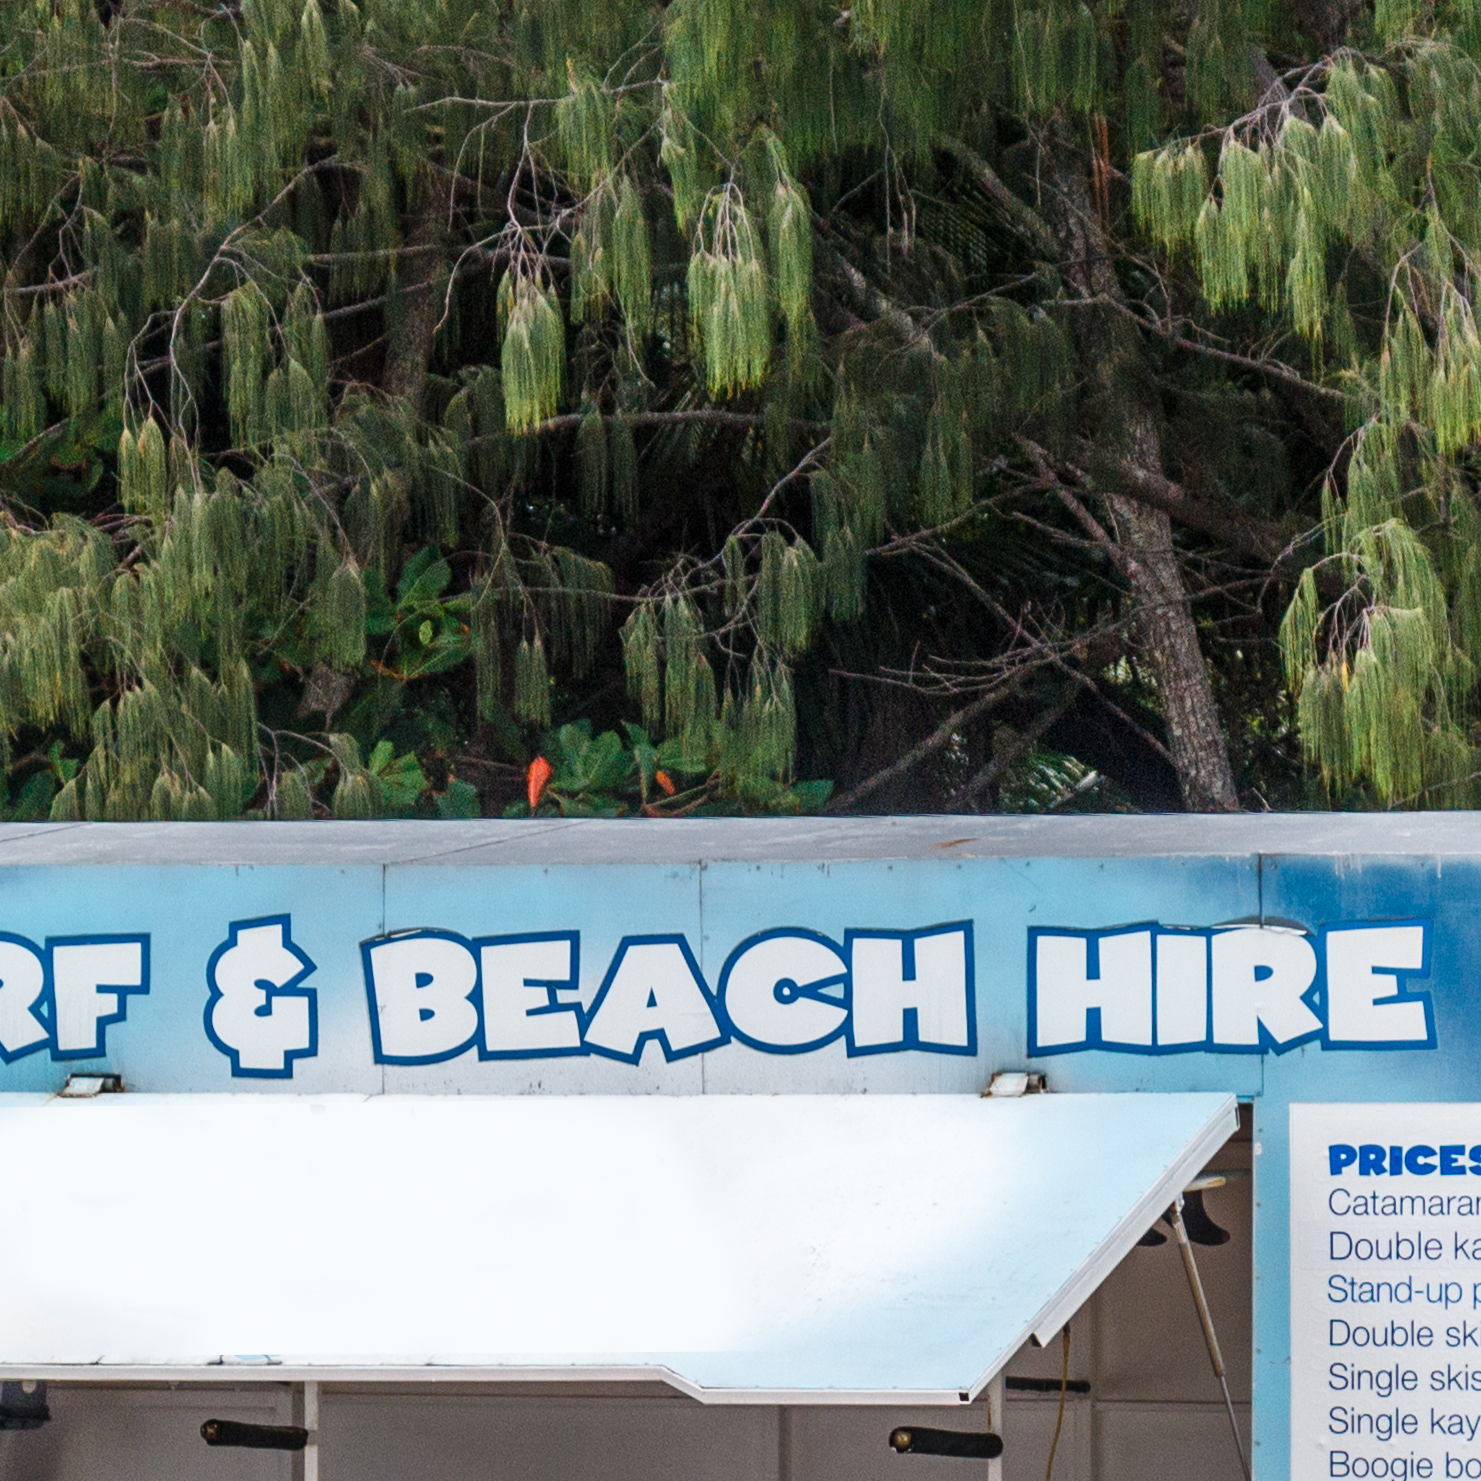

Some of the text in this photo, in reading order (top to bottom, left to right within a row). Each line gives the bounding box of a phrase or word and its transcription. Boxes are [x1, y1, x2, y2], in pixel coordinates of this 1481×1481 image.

[204, 913, 318, 1079] &
[359, 920, 978, 1066] BEACH
[1027, 917, 1438, 1057] HIRE
[1329, 1230, 1443, 1261] Double
[1327, 1273, 1463, 1310] Stand-up
[1329, 1318, 1434, 1348] Double
[1328, 1362, 1419, 1398] Single
[1328, 1405, 1419, 1442] Single
